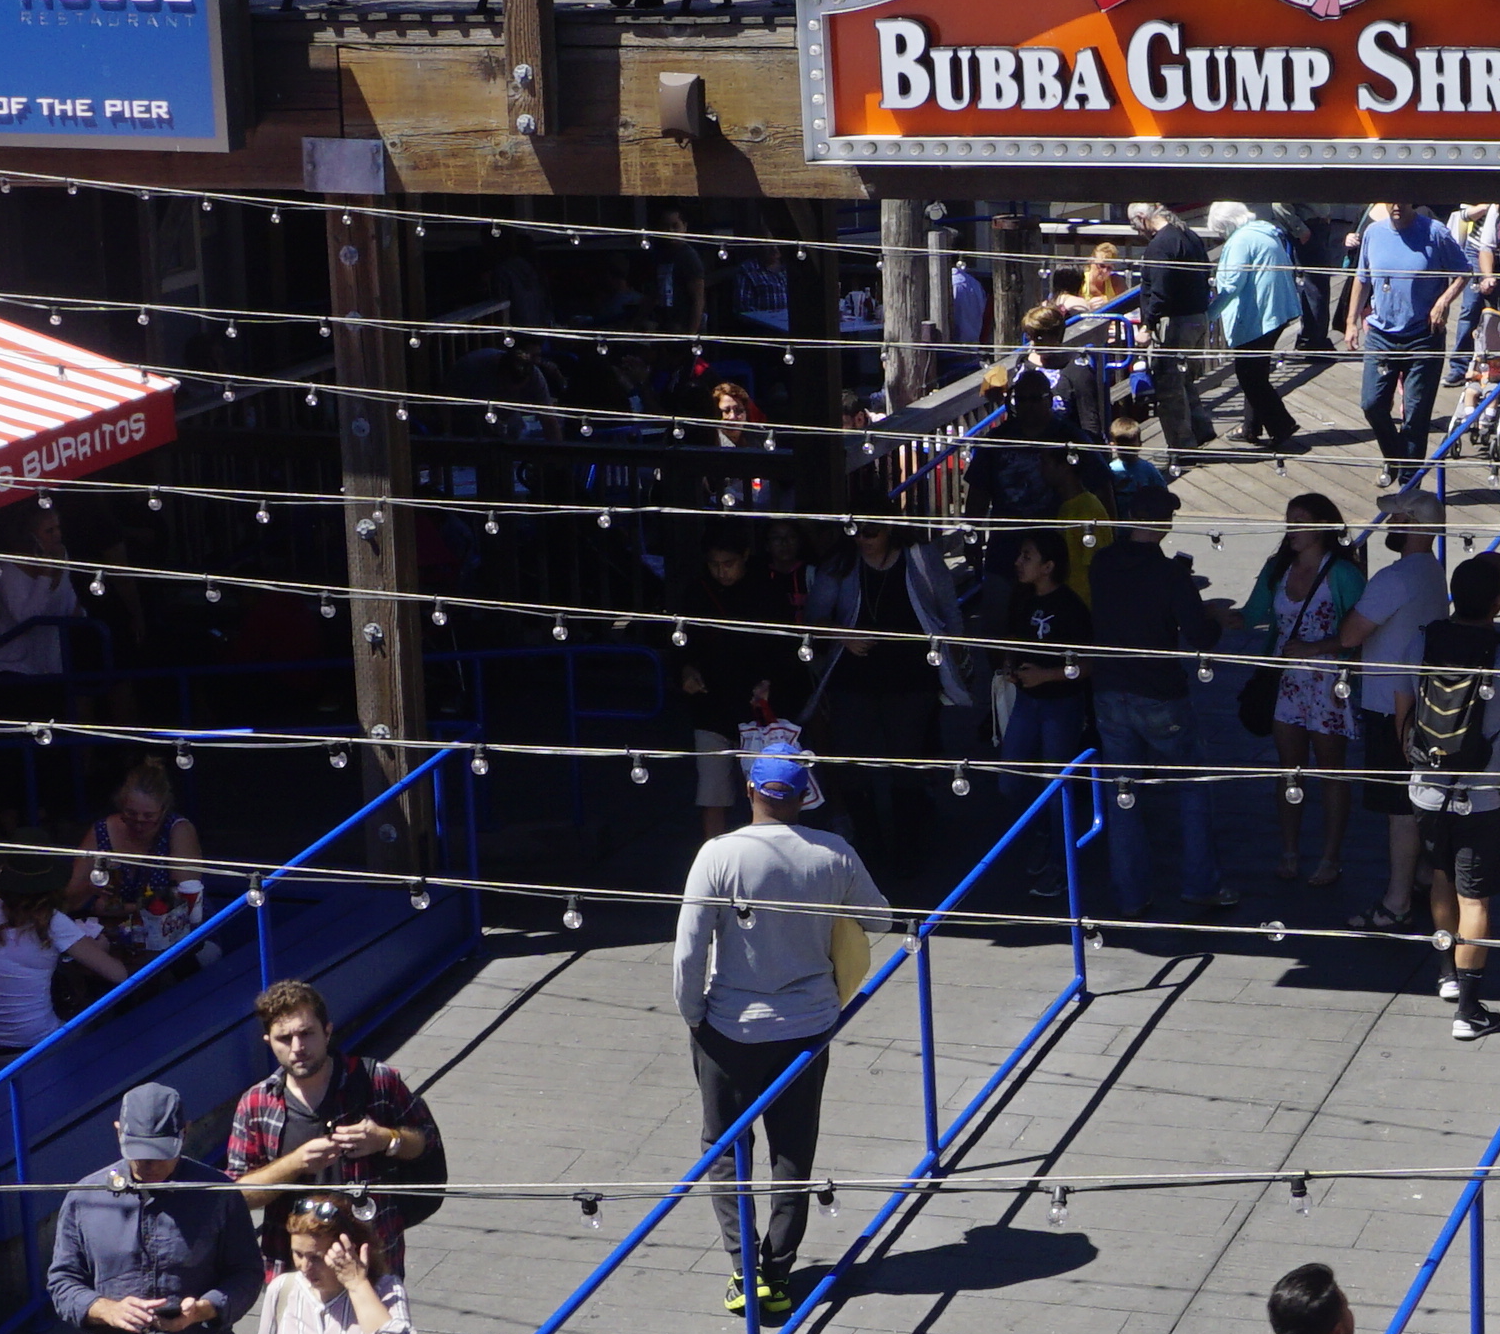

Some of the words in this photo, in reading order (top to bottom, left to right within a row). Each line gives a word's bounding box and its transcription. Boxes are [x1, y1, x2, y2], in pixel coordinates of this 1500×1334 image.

[876, 18, 1115, 113] BUBBA
[1128, 19, 1334, 114] GUMP
[36, 98, 93, 117] THE
[104, 99, 170, 119] PIER
[20, 411, 148, 482] BURRITOS
